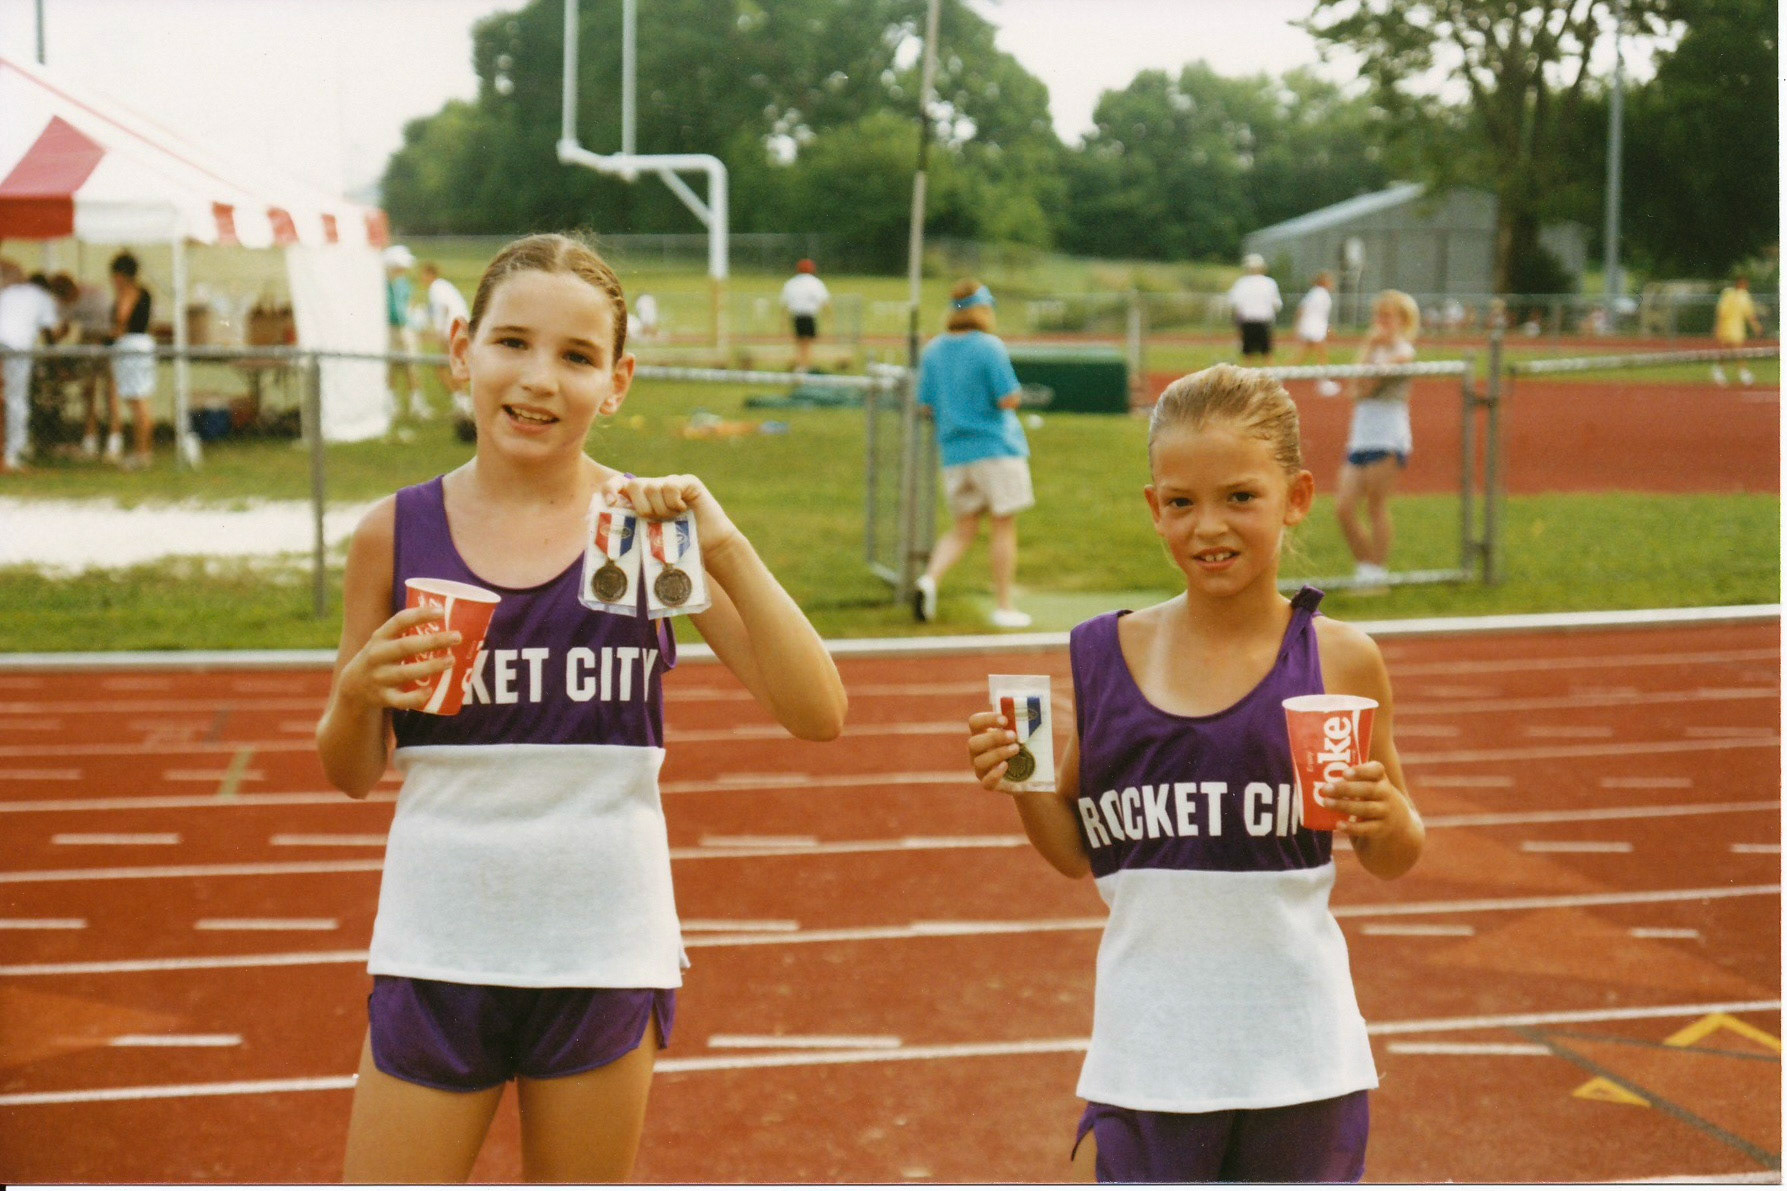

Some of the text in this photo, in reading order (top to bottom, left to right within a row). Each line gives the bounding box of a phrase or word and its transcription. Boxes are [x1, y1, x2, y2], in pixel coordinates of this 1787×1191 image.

[462, 647, 549, 704] KET
[566, 647, 658, 703] CITY
[1078, 781, 1299, 849] ROCKET CI
